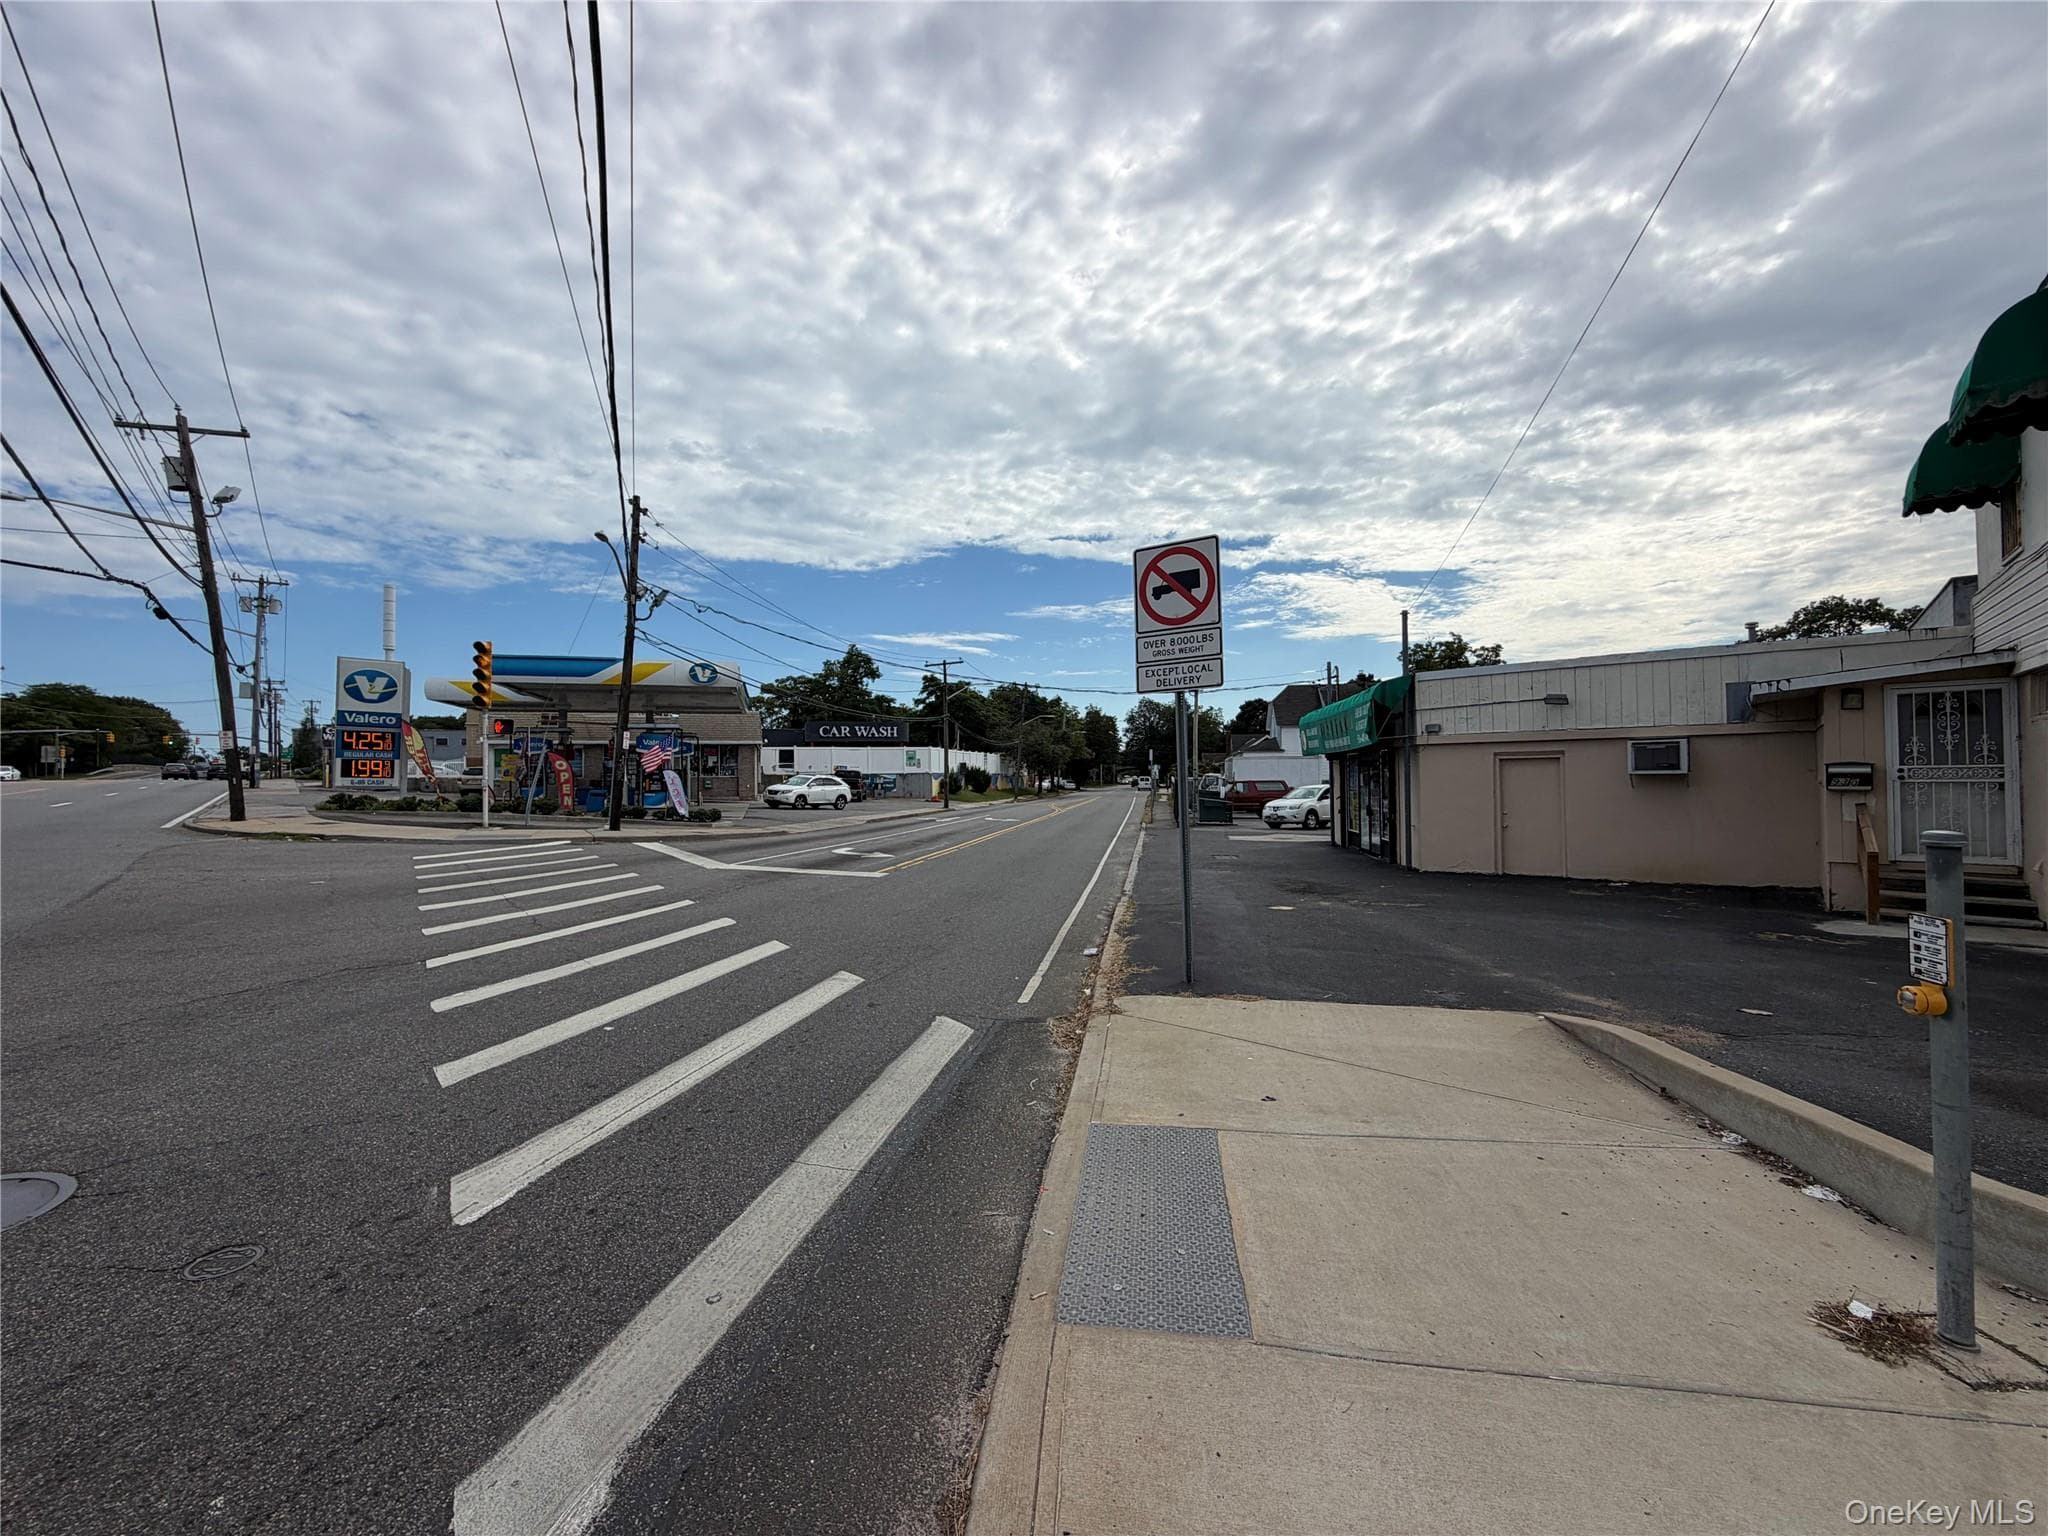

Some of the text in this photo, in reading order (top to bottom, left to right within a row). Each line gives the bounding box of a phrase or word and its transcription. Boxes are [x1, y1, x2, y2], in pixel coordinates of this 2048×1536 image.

[1143, 639, 1166, 649] OVER
[1196, 633, 1214, 643] LBS
[1152, 645, 1204, 657] GROSS WEIGHT
[1145, 663, 1213, 678] EXCEPT LOCAL
[1156, 675, 1201, 688] DELIVERY
[344, 712, 397, 725] Valero
[819, 725, 898, 738] CAR WASH
[343, 731, 384, 750] 4.25
[352, 760, 383, 777] 1.99
[555, 760, 572, 806] OPEN
